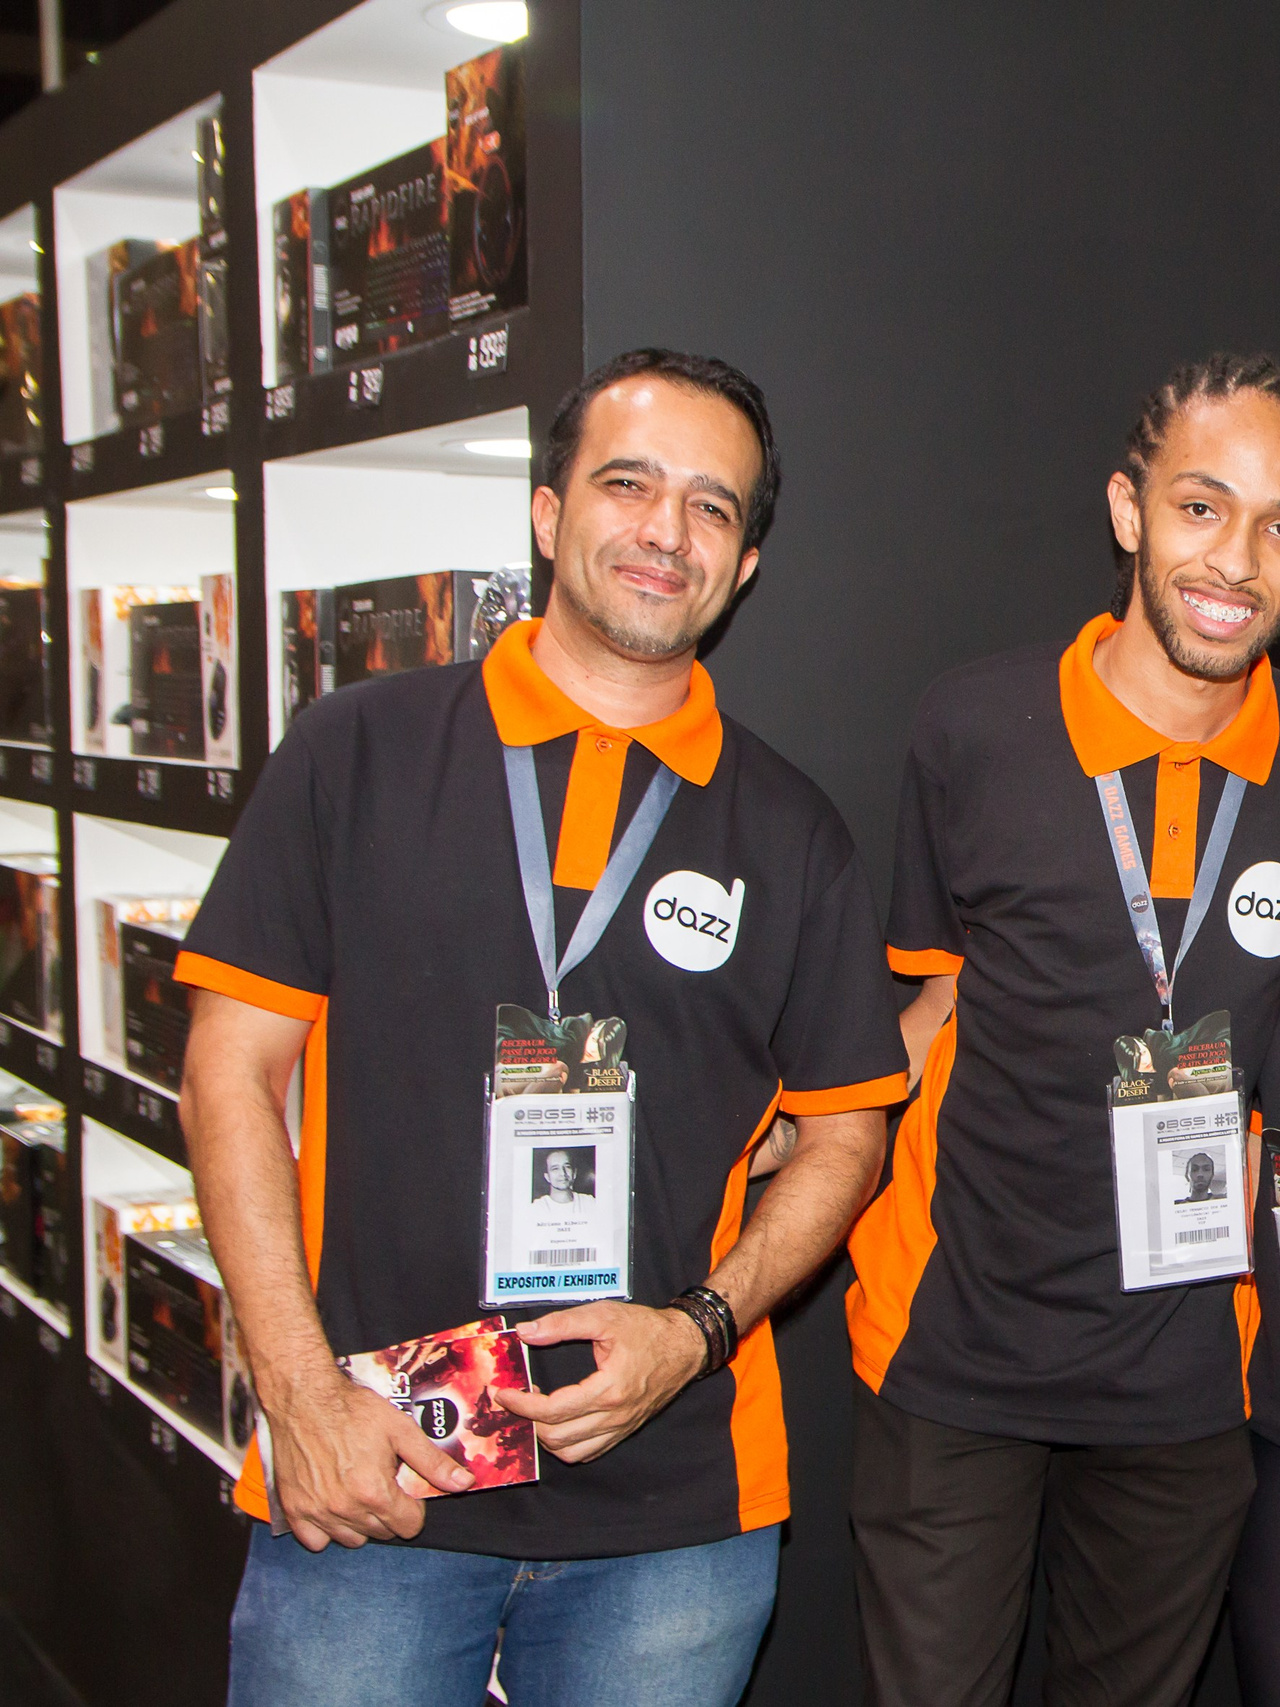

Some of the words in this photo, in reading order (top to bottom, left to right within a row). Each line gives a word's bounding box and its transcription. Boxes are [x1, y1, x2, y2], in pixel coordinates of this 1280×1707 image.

[1104, 786, 1125, 821] DAZZ
[1114, 825, 1137, 871] GAMES
[653, 897, 731, 944] dazz
[592, 1068, 620, 1077] BLACK
[1121, 1079, 1146, 1089] BLACK
[527, 1108, 576, 1120] BGS
[1166, 1116, 1206, 1129] BGS
[498, 1275, 556, 1289] EXPOSITOR
[563, 1273, 617, 1287] EXHIBITOR
[389, 1371, 413, 1416] MES
[432, 1400, 447, 1438] dazz
